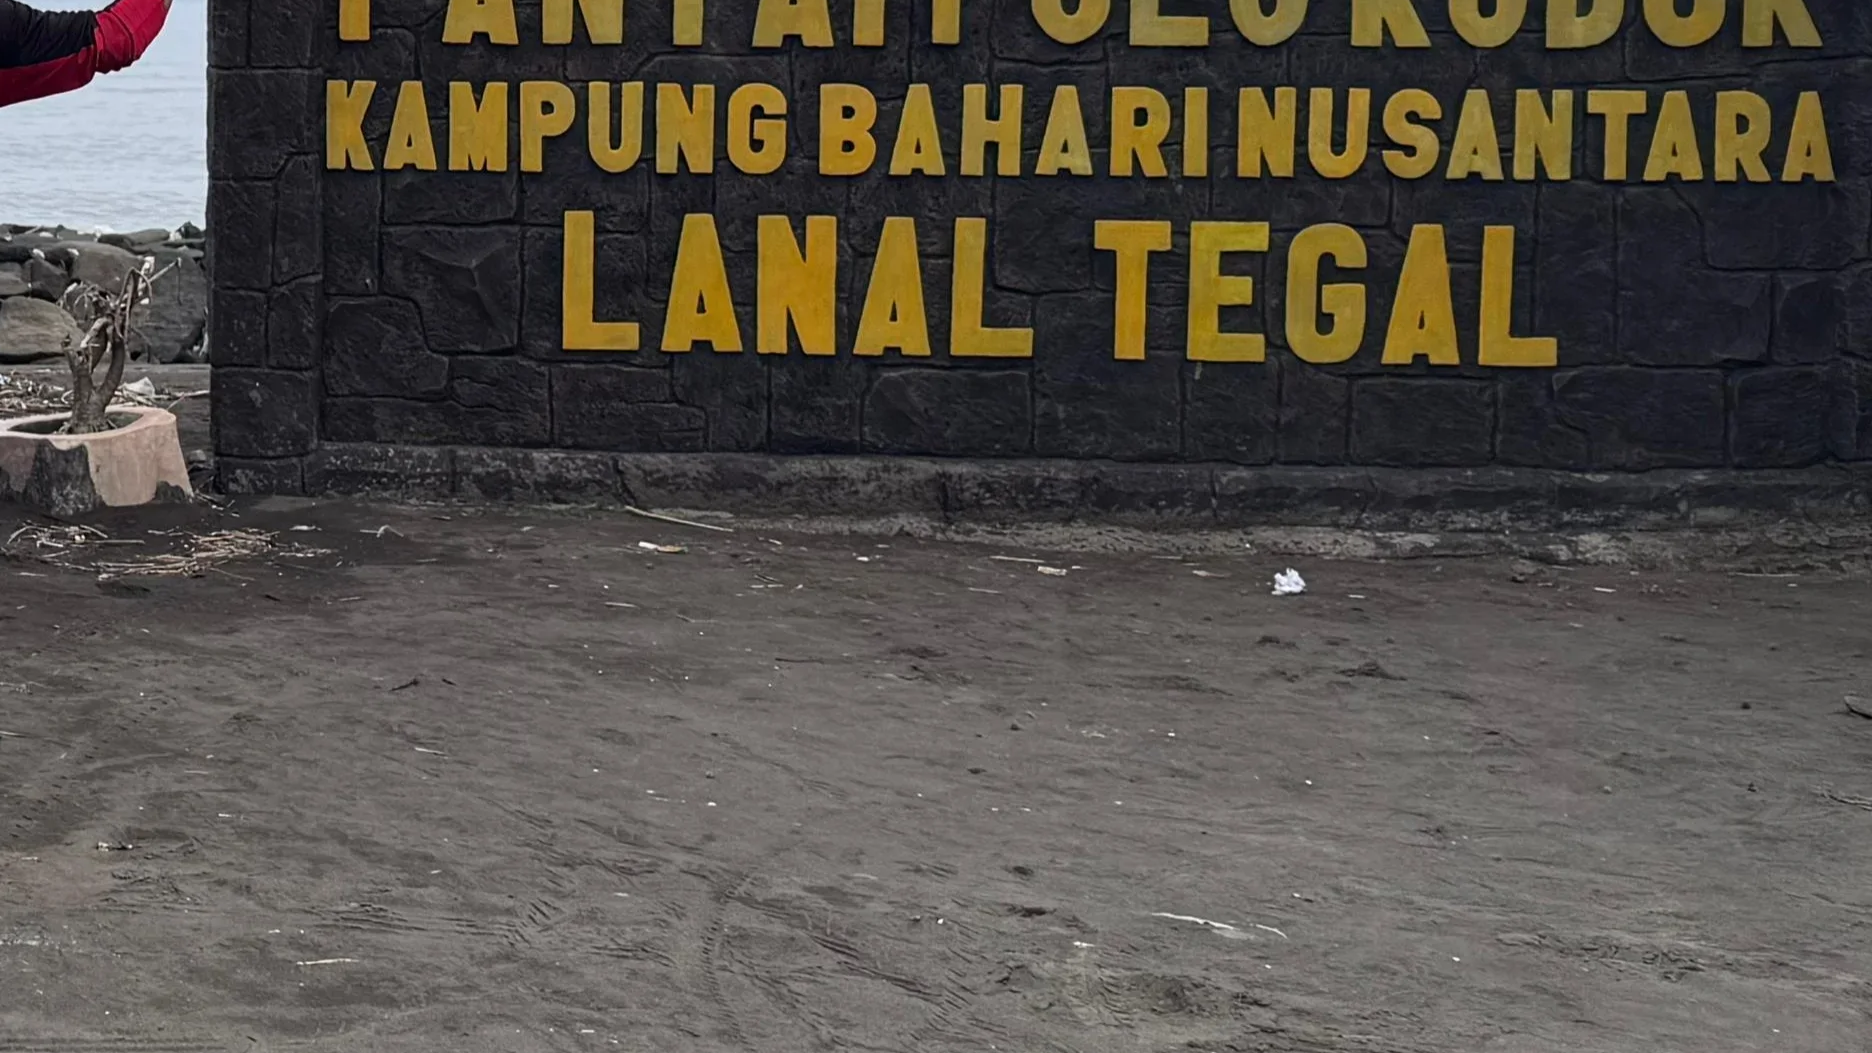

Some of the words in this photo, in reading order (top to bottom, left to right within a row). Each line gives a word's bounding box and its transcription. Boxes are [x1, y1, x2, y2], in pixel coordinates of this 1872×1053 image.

[326, 79, 788, 176] KAMPUNG
[818, 83, 1208, 178] BAHARI
[1237, 86, 1836, 183] NUSANTARA
[561, 210, 1034, 357] LANAL
[1094, 219, 1558, 367] TEGAL
